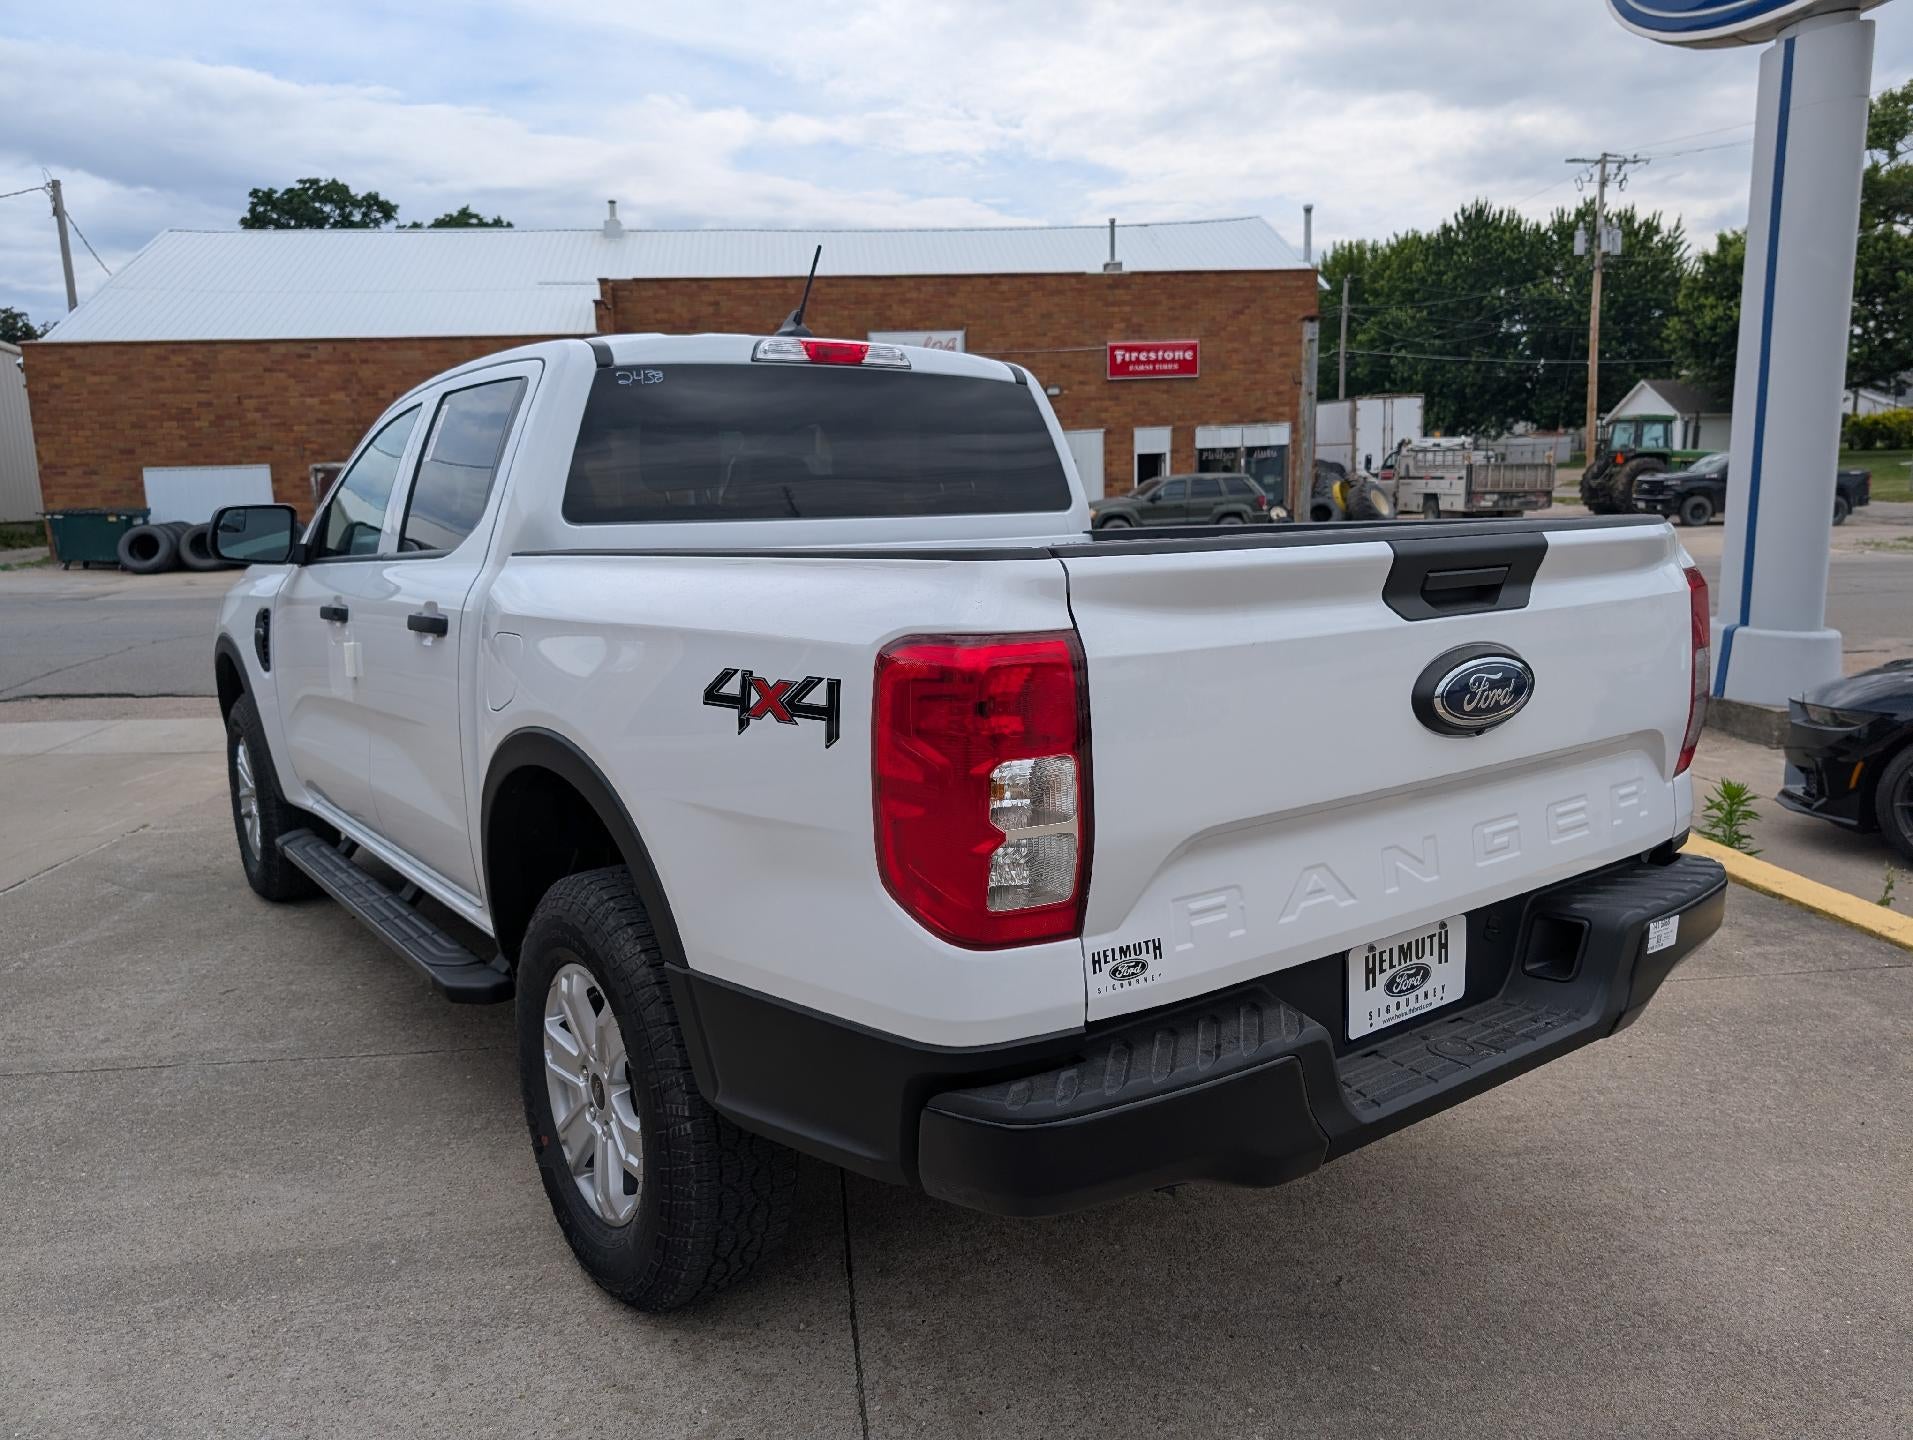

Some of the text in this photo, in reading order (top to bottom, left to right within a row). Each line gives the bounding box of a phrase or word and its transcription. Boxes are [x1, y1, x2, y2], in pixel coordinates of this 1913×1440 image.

[1114, 349, 1194, 365] Firestone
[1463, 671, 1516, 712] Ford
[1170, 776, 1649, 951] RANGER
[1091, 937, 1163, 975] HELMUTH
[1114, 960, 1144, 979] Ford
[1364, 929, 1449, 992] HELMUTH
[1391, 967, 1425, 994] Ford
[1368, 984, 1446, 1021] SIGOURNEY
